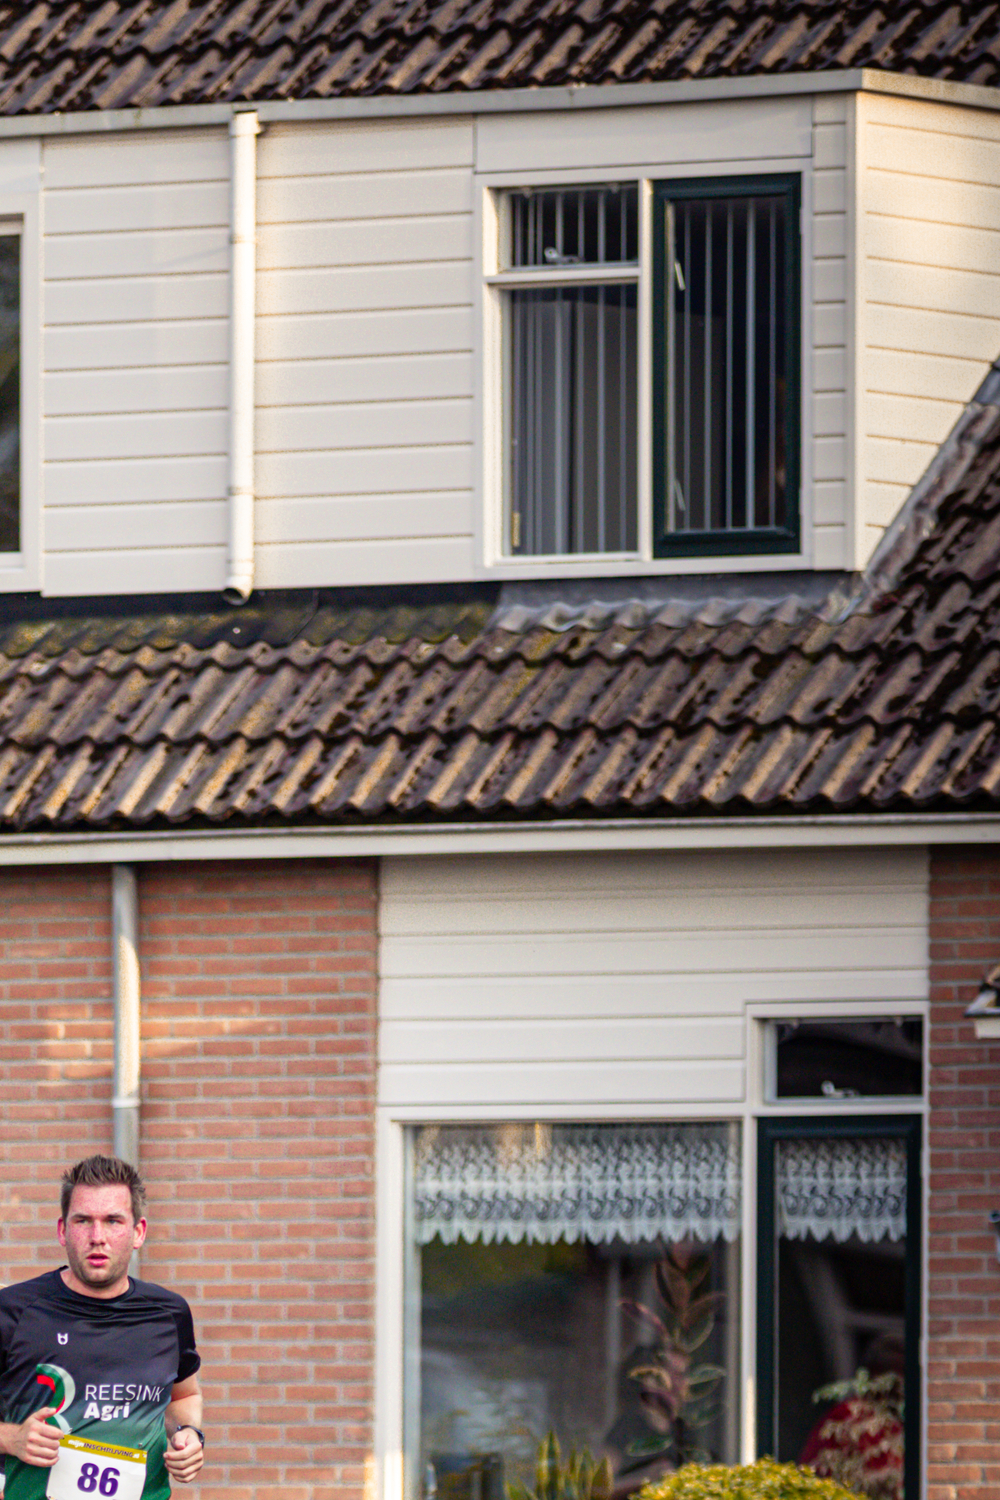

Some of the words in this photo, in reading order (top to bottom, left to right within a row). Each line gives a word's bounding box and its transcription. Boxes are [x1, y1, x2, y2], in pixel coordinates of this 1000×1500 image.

[84, 1384, 164, 1402] REESINK
[83, 1402, 130, 1421] Agri
[77, 1462, 121, 1497] 86
